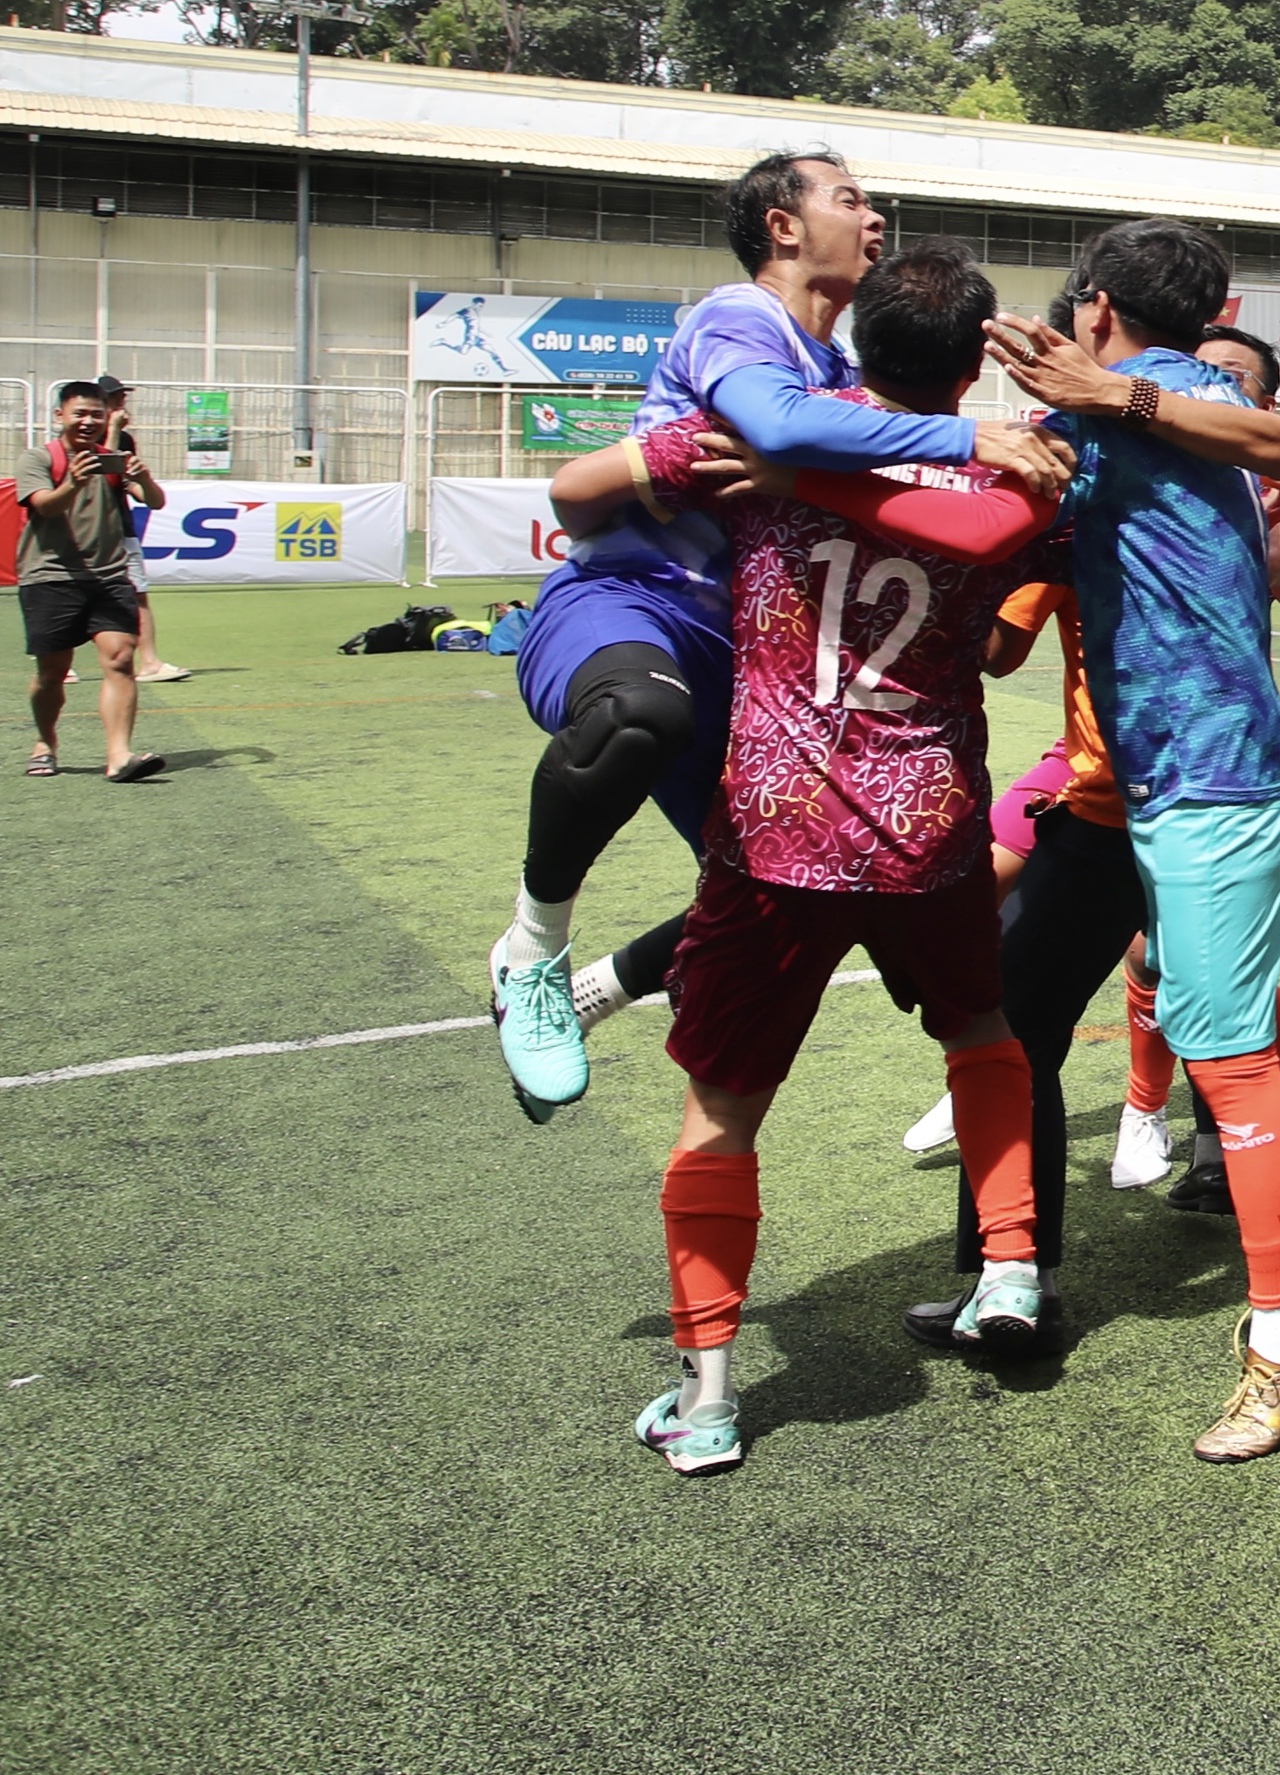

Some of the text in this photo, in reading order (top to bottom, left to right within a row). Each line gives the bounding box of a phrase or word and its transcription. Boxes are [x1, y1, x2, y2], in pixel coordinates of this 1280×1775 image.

[578, 334, 617, 355] LẠC
[622, 333, 649, 357] BỘ
[920, 465, 972, 493] VIÊN
[279, 538, 338, 558] TSB
[809, 538, 932, 712] 12
